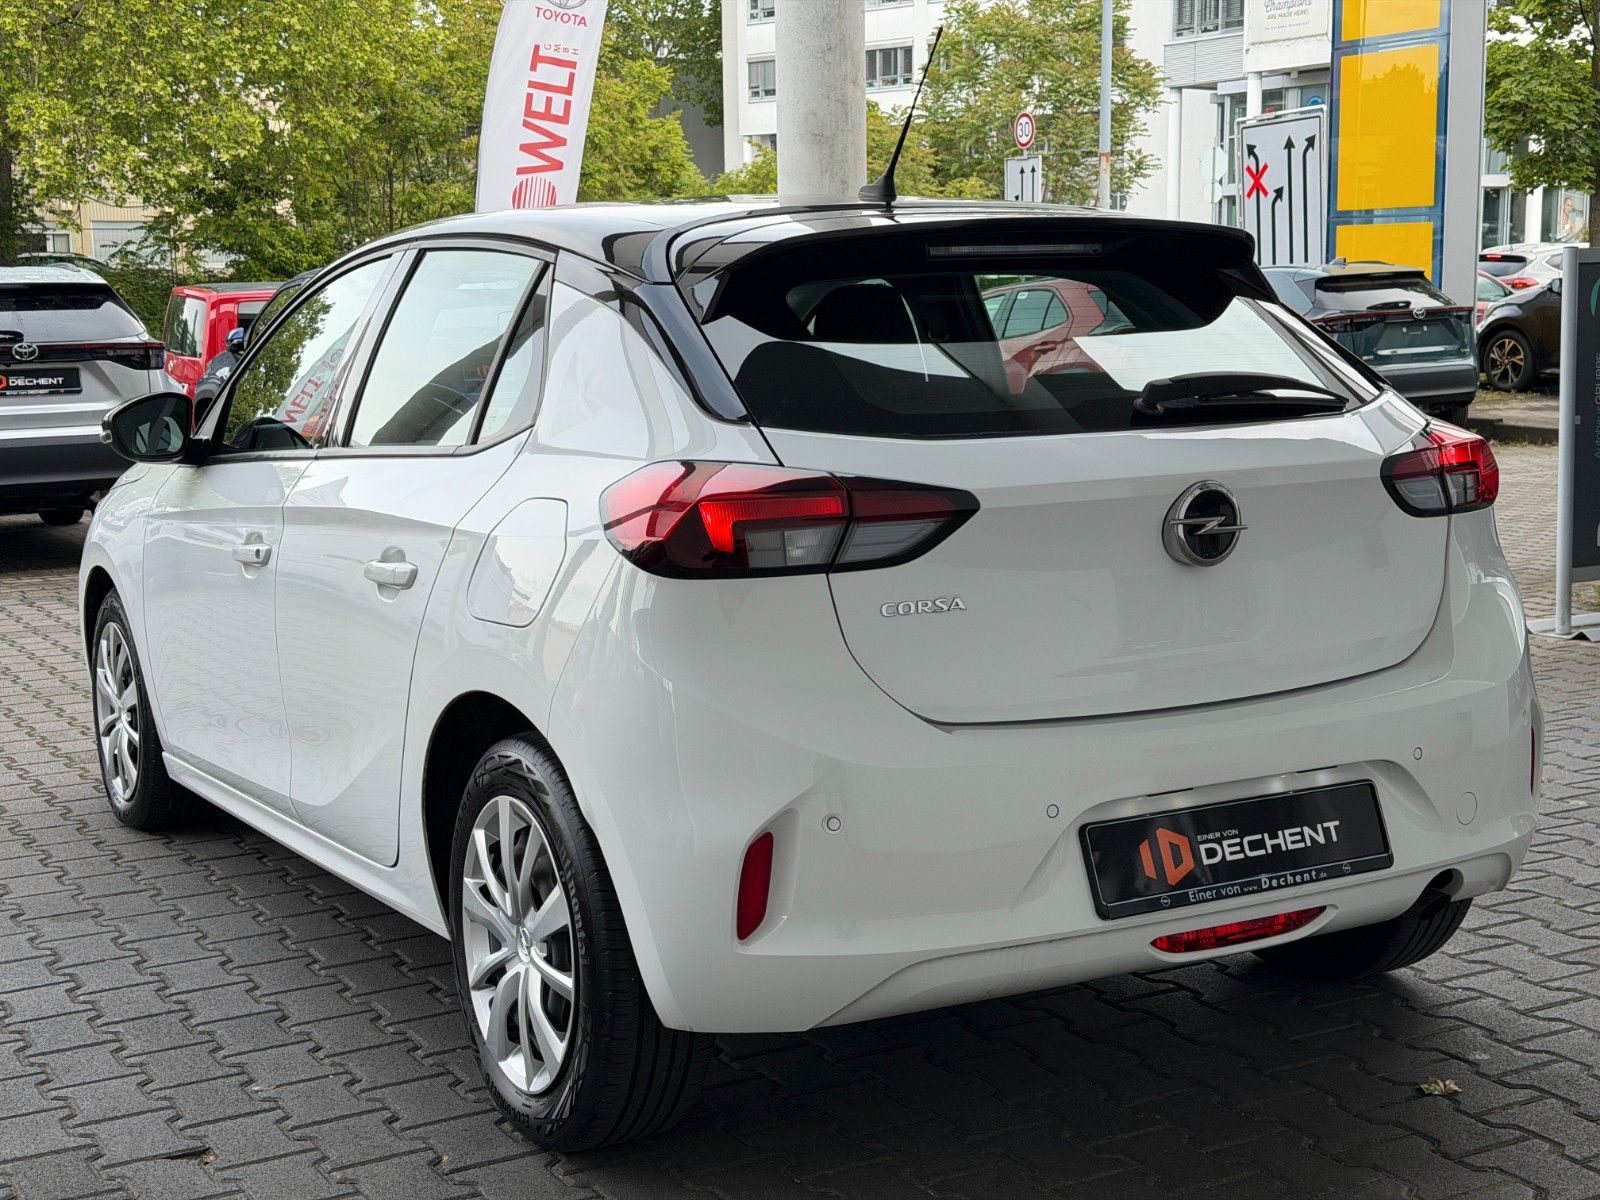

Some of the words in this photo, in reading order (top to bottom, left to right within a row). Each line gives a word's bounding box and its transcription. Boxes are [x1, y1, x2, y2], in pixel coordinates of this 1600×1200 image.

[535, 6, 588, 27] TOYOTA
[516, 44, 577, 176] WELT
[1019, 121, 1030, 138] 30
[8, 377, 64, 386] DECHENT
[880, 597, 967, 618] CORSA
[1197, 830, 1221, 842] EINER
[1222, 828, 1239, 838] VON
[1198, 821, 1340, 866] DECHENT
[1188, 889, 1217, 903] Einer
[1220, 885, 1241, 897] von
